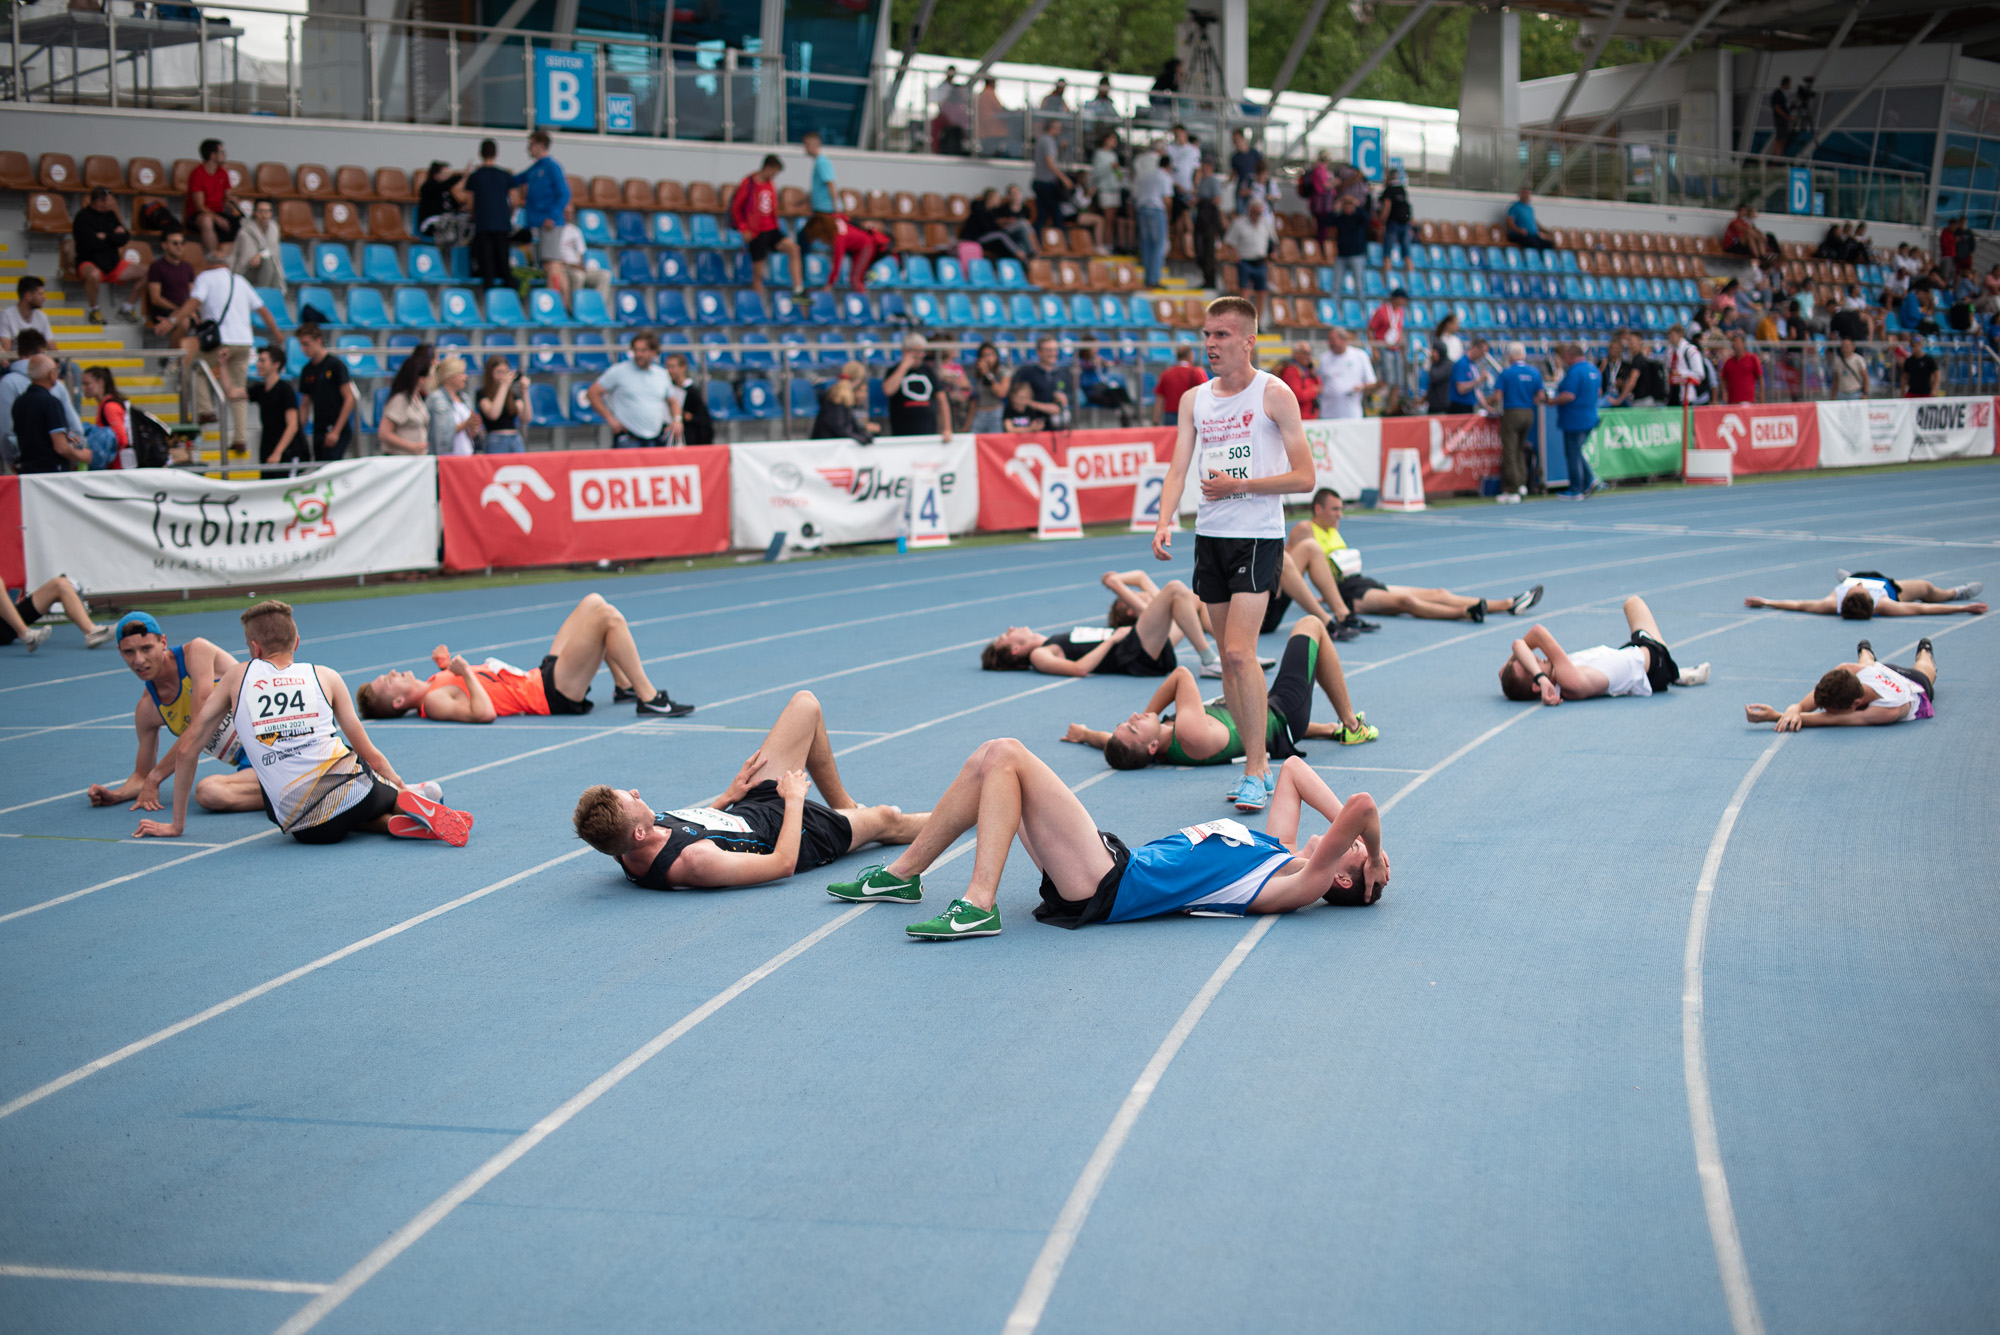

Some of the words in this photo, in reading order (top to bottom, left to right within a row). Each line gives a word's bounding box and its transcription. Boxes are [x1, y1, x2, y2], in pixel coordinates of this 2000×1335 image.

[550, 70, 581, 121] B
[608, 100, 632, 115] WC
[1357, 139, 1377, 177] C
[1793, 179, 1808, 210] D
[1633, 421, 1682, 447] LUBLIN
[1754, 421, 1796, 441] ORLEN
[1075, 449, 1148, 481] ORLEN
[1228, 445, 1251, 460] 503
[581, 474, 692, 511] ORLEN
[1391, 461, 1402, 496] 1
[919, 487, 939, 528] 4
[1050, 482, 1070, 521] 3
[1144, 475, 1164, 515] 2
[1232, 492, 1247, 500] 2021
[274, 678, 304, 686] ORLEN
[258, 690, 306, 718] 294
[264, 722, 288, 732] LUBLIN
[288, 720, 305, 729] 2021
